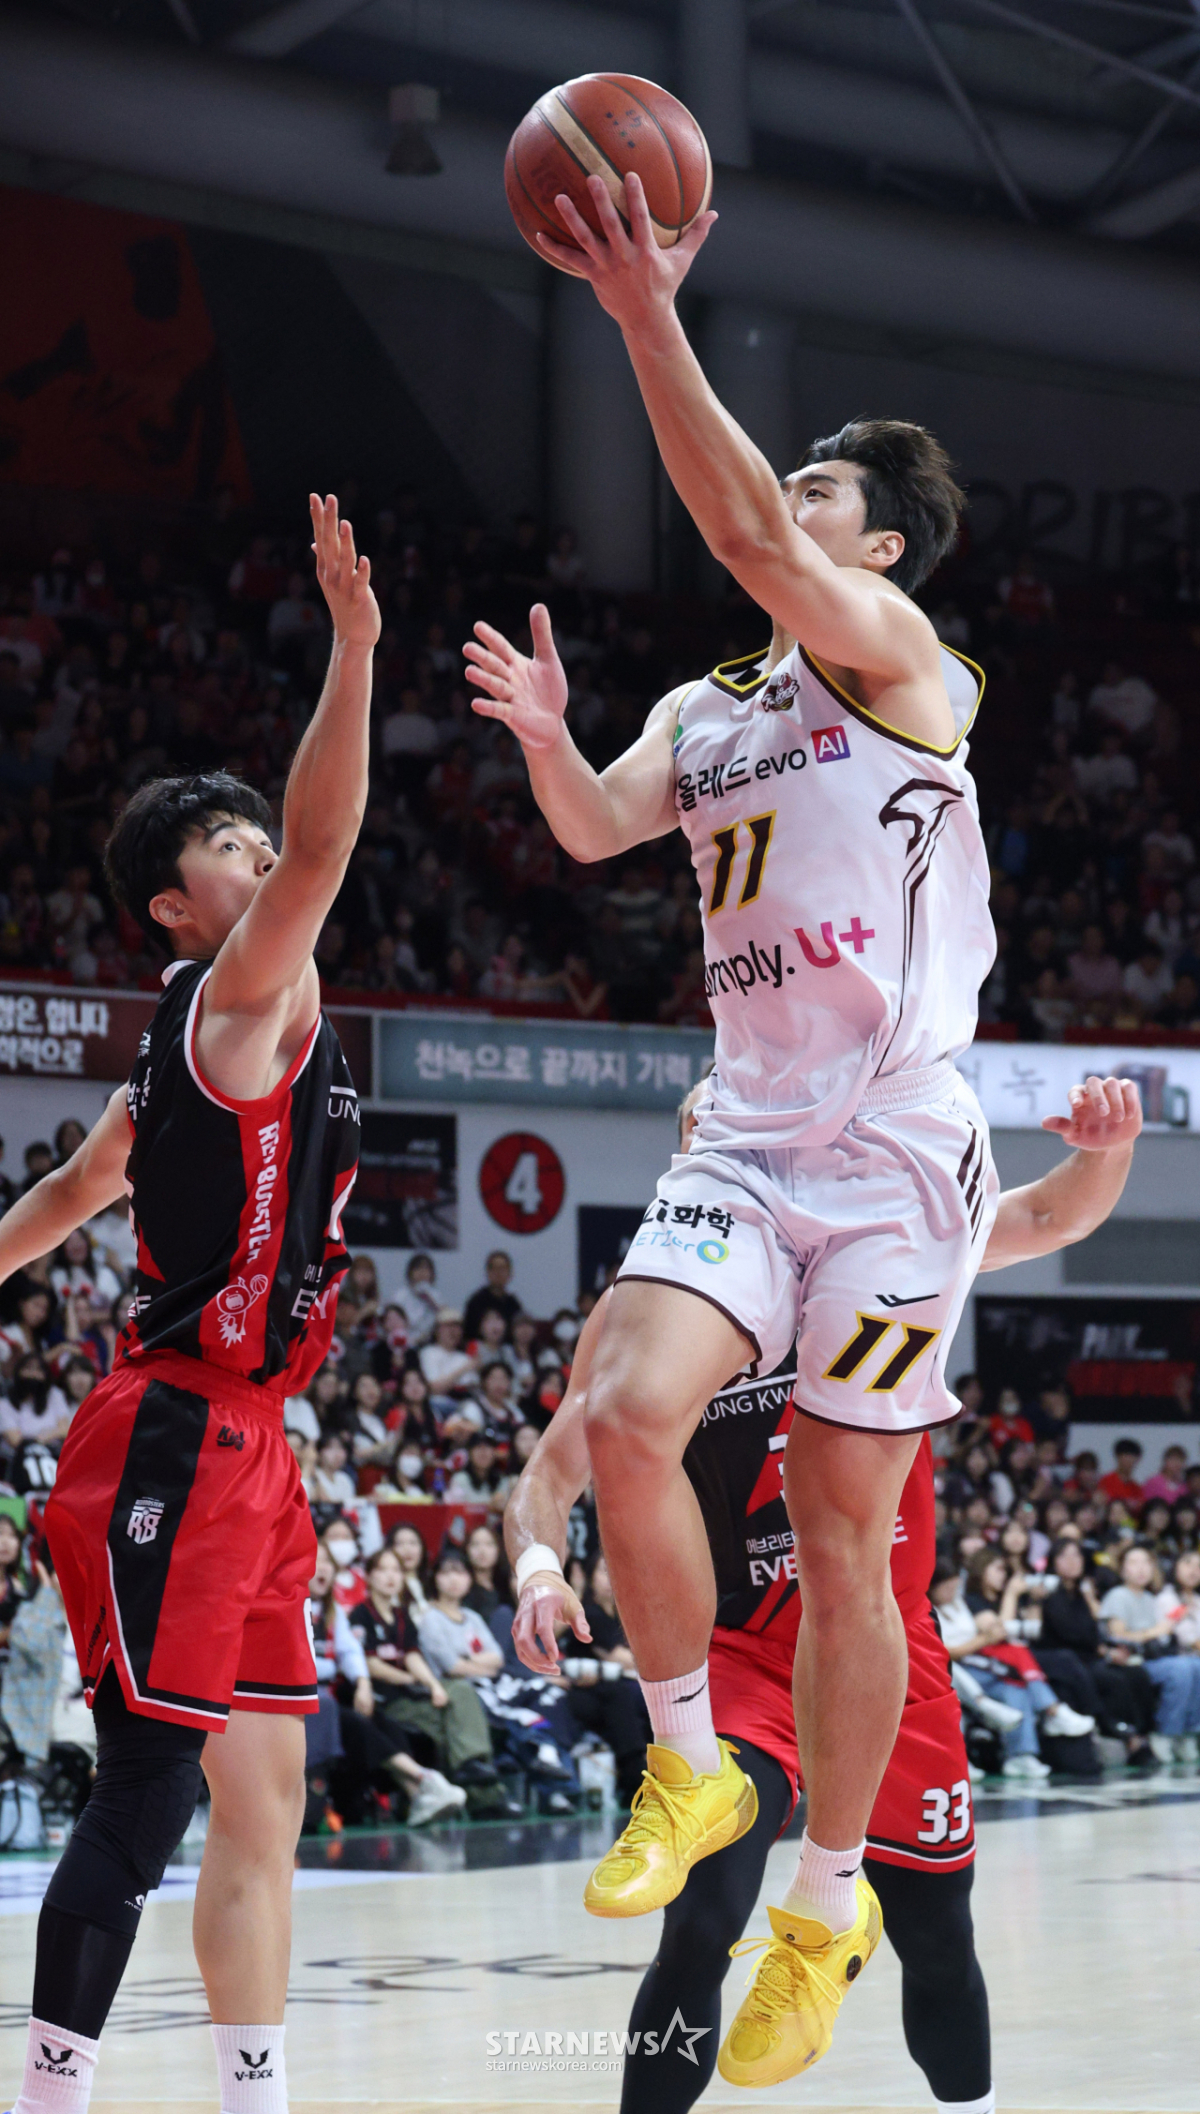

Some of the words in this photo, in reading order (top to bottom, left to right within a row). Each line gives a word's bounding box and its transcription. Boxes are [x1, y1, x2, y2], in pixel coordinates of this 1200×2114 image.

[678, 756, 751, 812] 올레드
[755, 748, 807, 780] evo
[818, 731, 846, 758] AI
[708, 809, 777, 919] 11
[704, 940, 795, 998] imply.
[794, 917, 875, 968] U+
[540, 1046, 628, 1090] 끝까지
[328, 1097, 361, 1126] UN
[505, 1152, 543, 1215] 4
[821, 1310, 942, 1393] 11
[702, 1395, 753, 1427] JUNG
[756, 1383, 797, 1412] KW
[917, 1779, 970, 1844] 33
[34, 2060, 78, 2077] V-EXX
[234, 2068, 273, 2082] V-EXX
